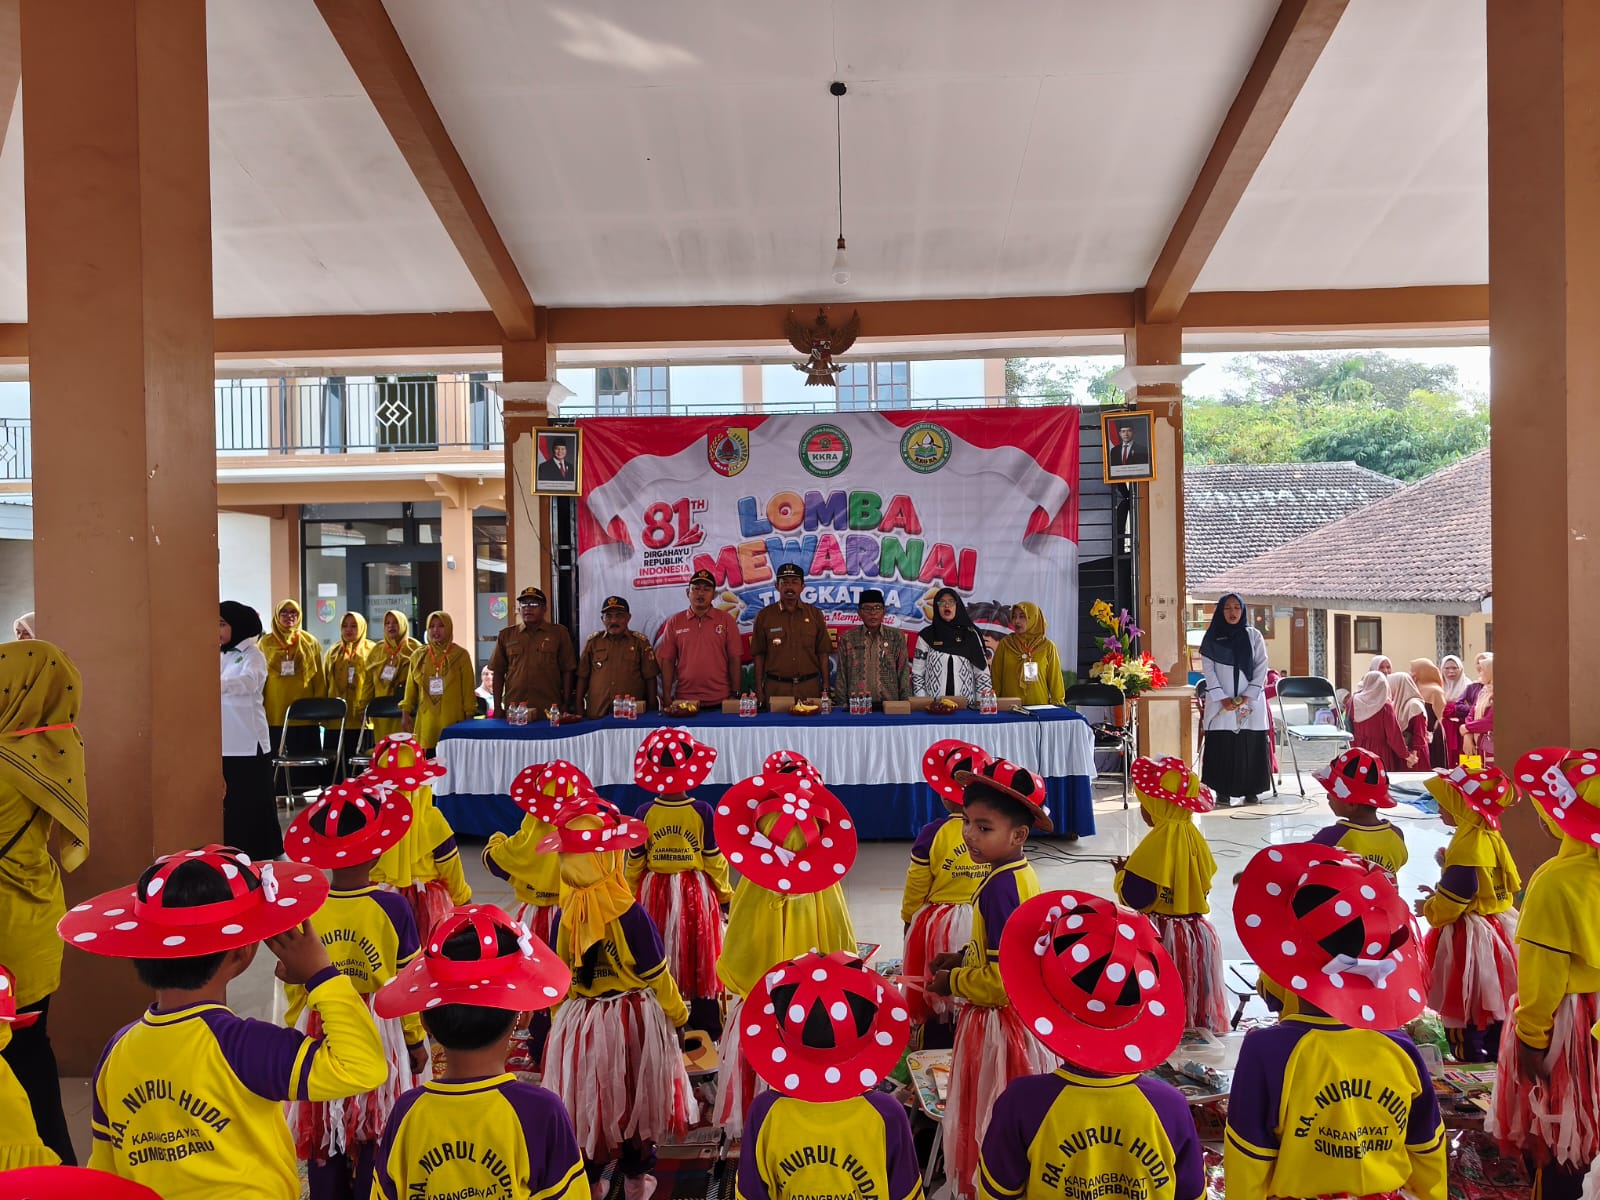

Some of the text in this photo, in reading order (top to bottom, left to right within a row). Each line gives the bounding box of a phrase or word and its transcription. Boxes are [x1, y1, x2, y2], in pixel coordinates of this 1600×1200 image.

[812, 453, 838, 461] KKRA
[738, 490, 922, 537] LOMBA
[644, 548, 690, 559] DIRGAHAYU
[644, 557, 683, 567] REPUBLIK
[693, 533, 977, 591] MEWARNAI
[639, 565, 690, 576] INDONESIA
[758, 586, 864, 607] TIGKAT
[653, 825, 701, 853] NURUL HUDA
[359, 936, 383, 972] HUDA
[110, 1078, 232, 1150] RA. NURUL HUDA
[1294, 1078, 1407, 1138] RA. NURUL HUDA
[132, 1127, 201, 1146] KARANGBAYAT
[1318, 1126, 1389, 1142] KARANBAYAT
[128, 1140, 216, 1167] SUMBERBARU
[779, 1144, 839, 1177] NURUL
[1041, 1125, 1170, 1190] RA. NURUL HUDA
[418, 1140, 477, 1175] NURUL
[481, 1148, 513, 1199] HUDA
[1064, 1172, 1147, 1190] KARANGBAYAT
[1064, 1183, 1149, 1200] SUMBERBARU
